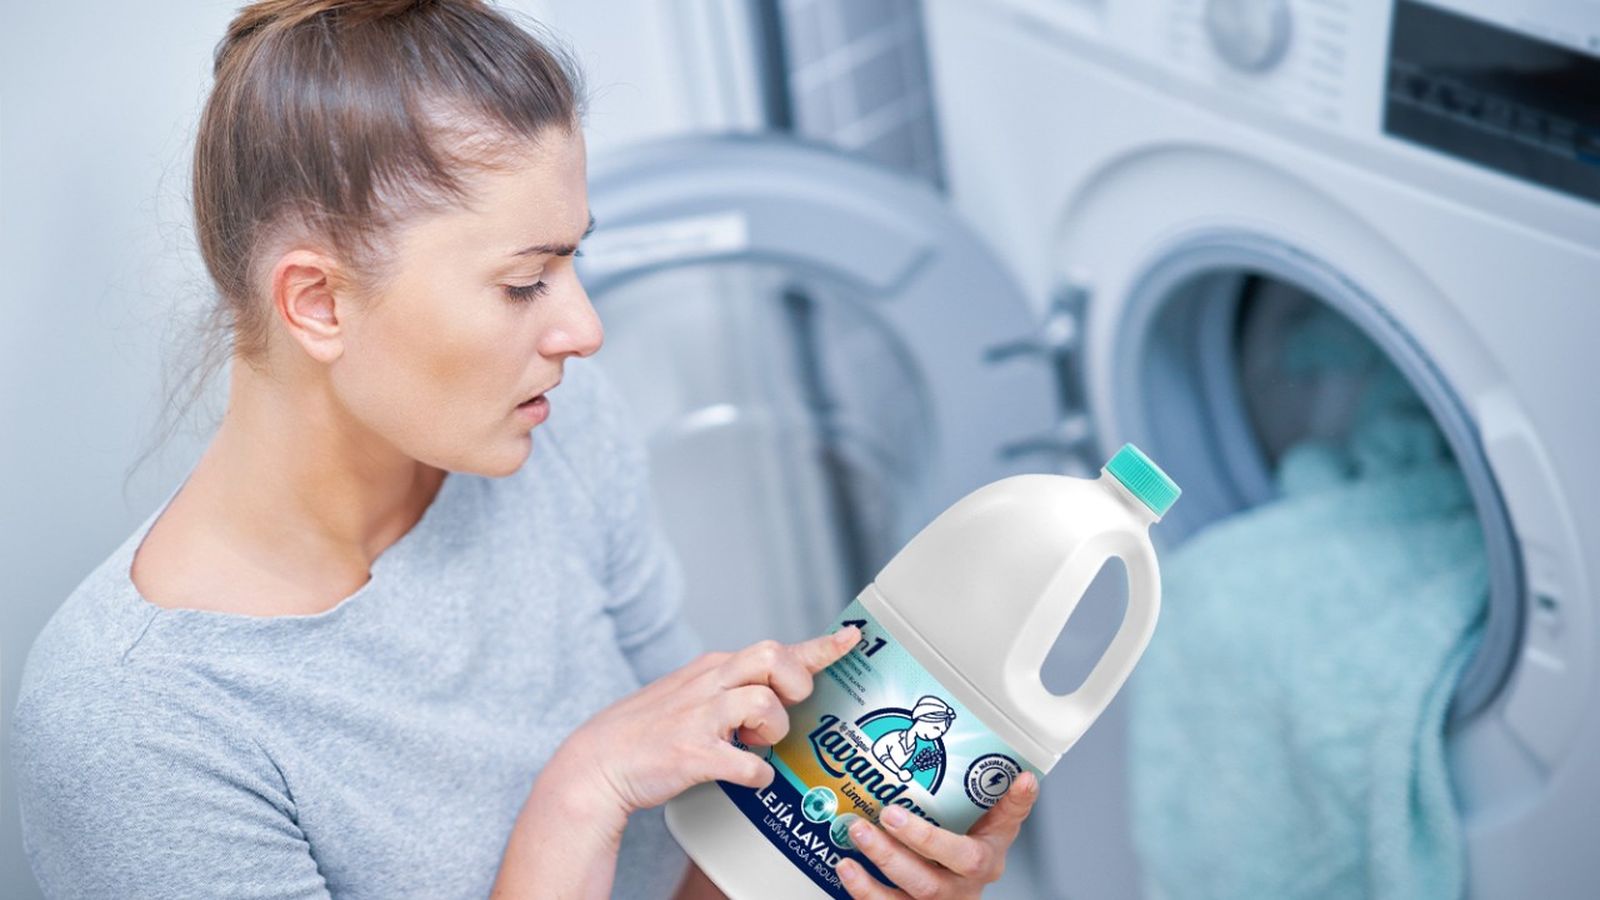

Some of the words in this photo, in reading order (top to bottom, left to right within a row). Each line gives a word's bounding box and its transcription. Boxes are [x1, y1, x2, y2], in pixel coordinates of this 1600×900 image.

[865, 636, 888, 658] 1
[808, 714, 941, 828] Lavande
[840, 782, 875, 817] Limpia
[755, 787, 794, 829] LEJÍA
[791, 821, 841, 869] LAVAD
[763, 814, 789, 843] LIXÍVIA
[788, 839, 810, 862] CASA
[808, 857, 817, 868] E
[814, 862, 842, 890] ROUPA
